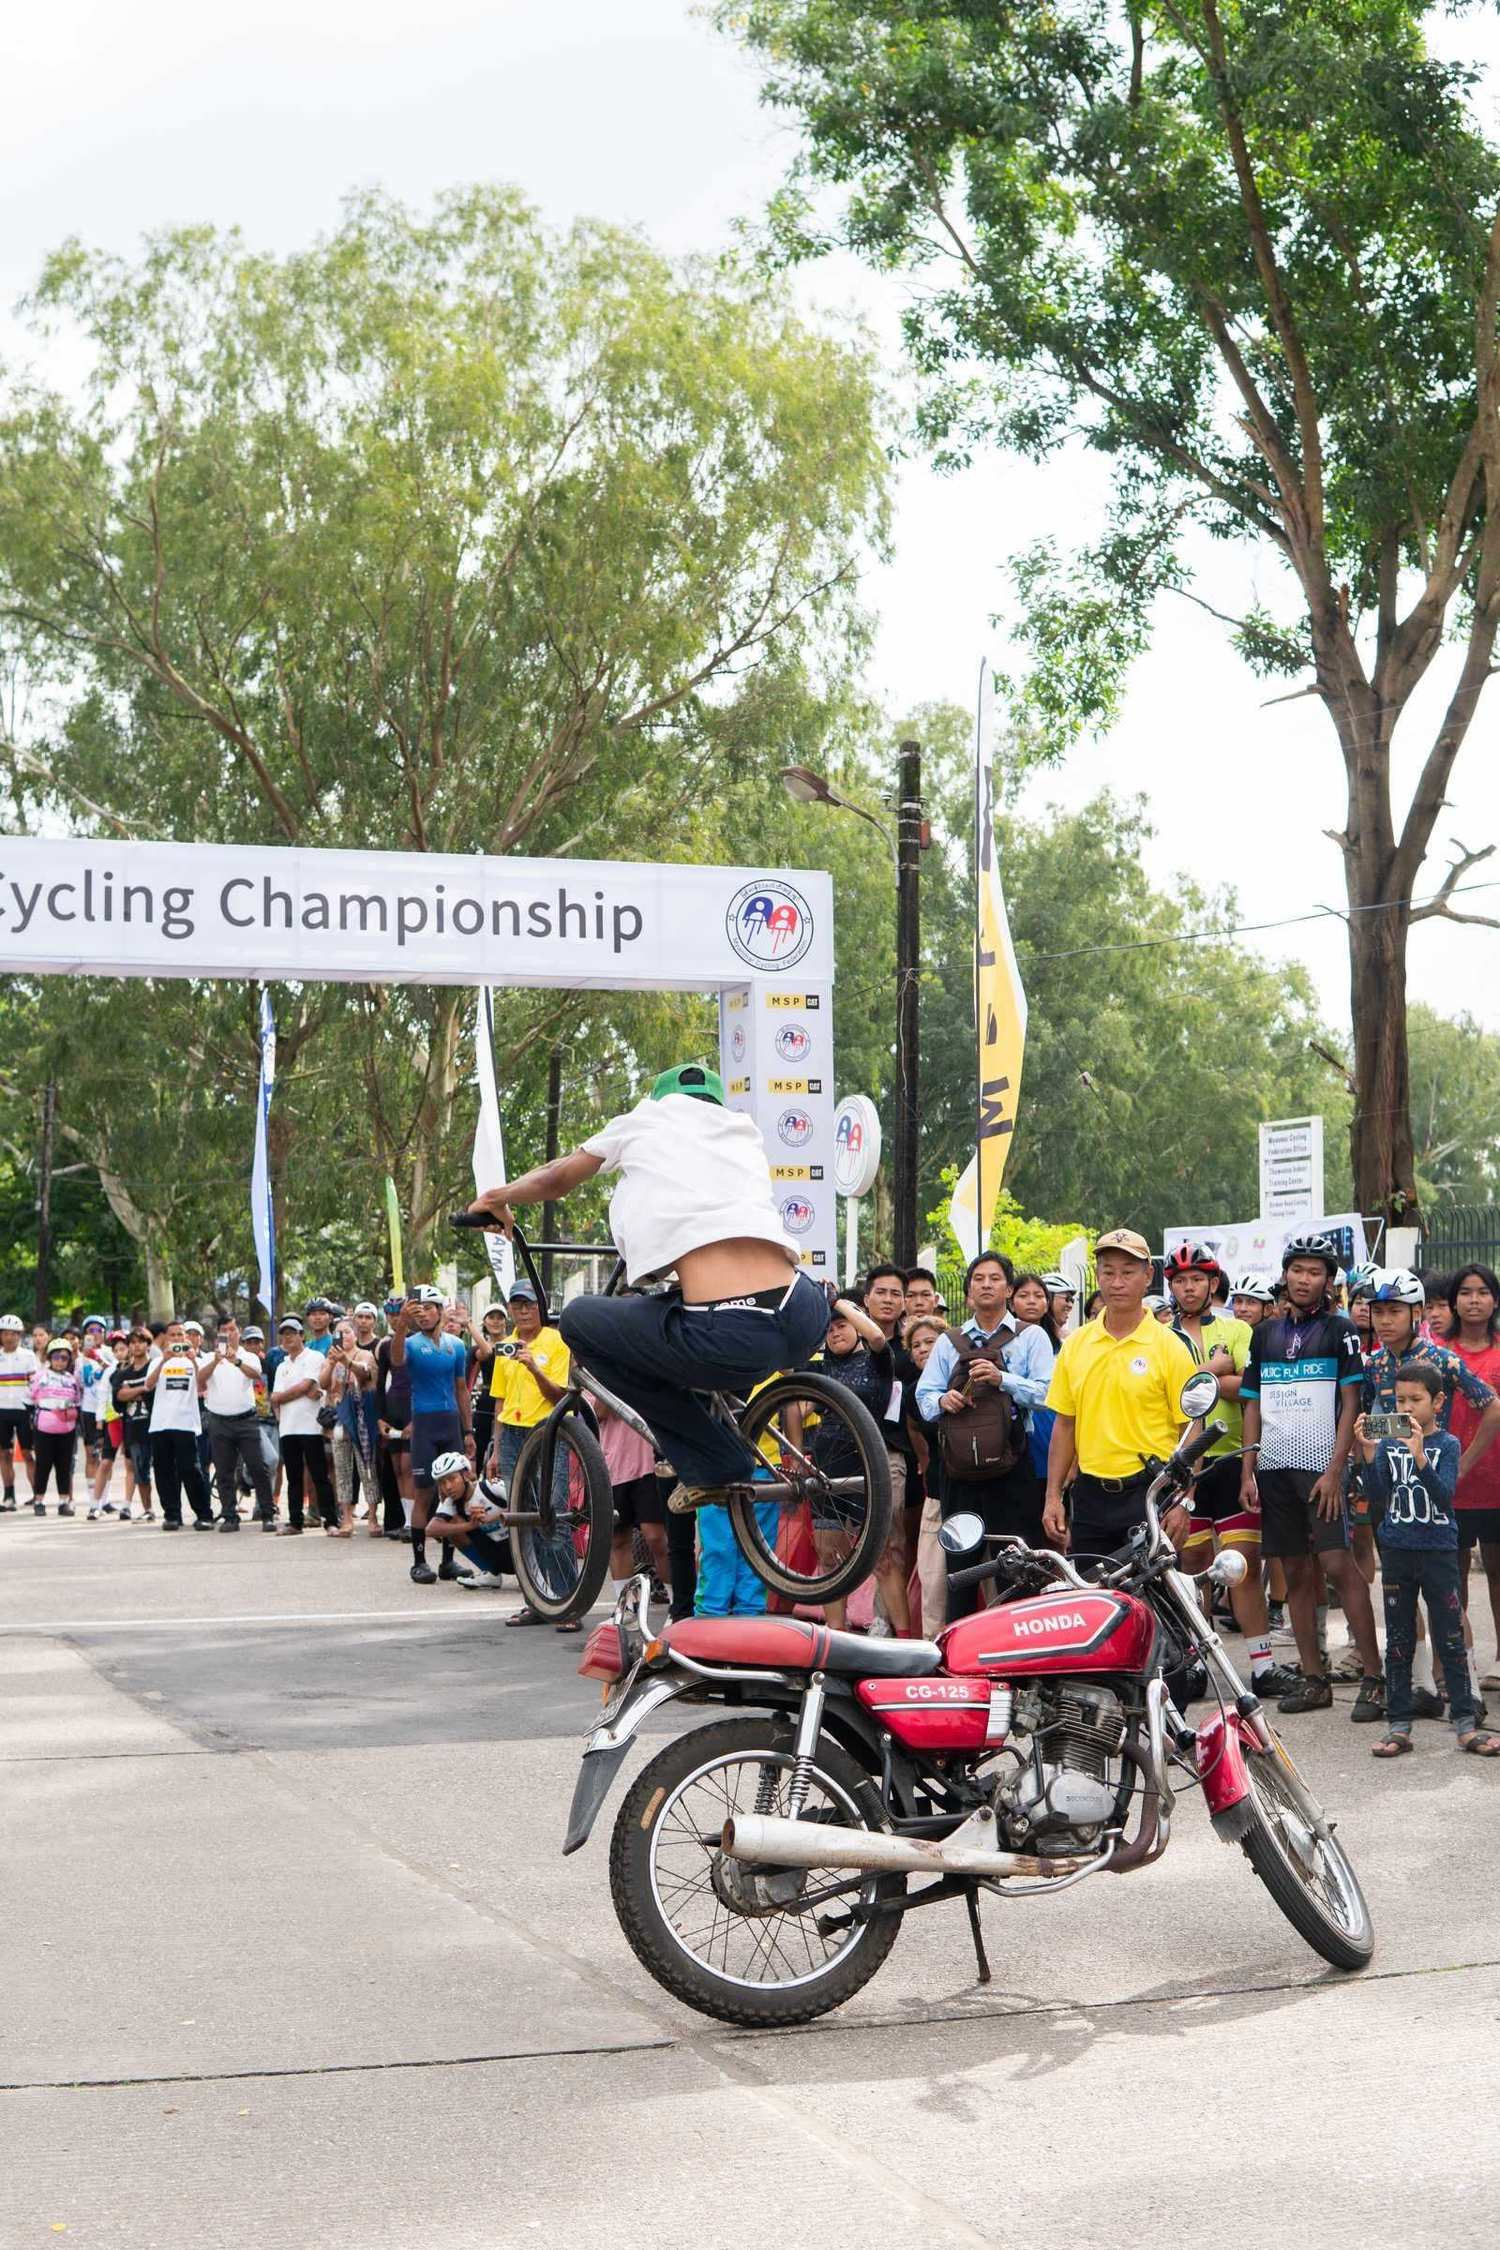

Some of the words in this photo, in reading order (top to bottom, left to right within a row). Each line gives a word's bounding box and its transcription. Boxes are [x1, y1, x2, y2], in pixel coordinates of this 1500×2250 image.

[0, 869, 195, 939] ycling
[219, 876, 643, 953] Championship
[772, 997, 800, 1005] MSP
[774, 1082, 802, 1090] MSP
[776, 1168, 804, 1176] MSP
[1303, 1363, 1327, 1375] RIDE
[1013, 1613, 1087, 1637] HONDA
[905, 1685, 969, 1698] CG-125
